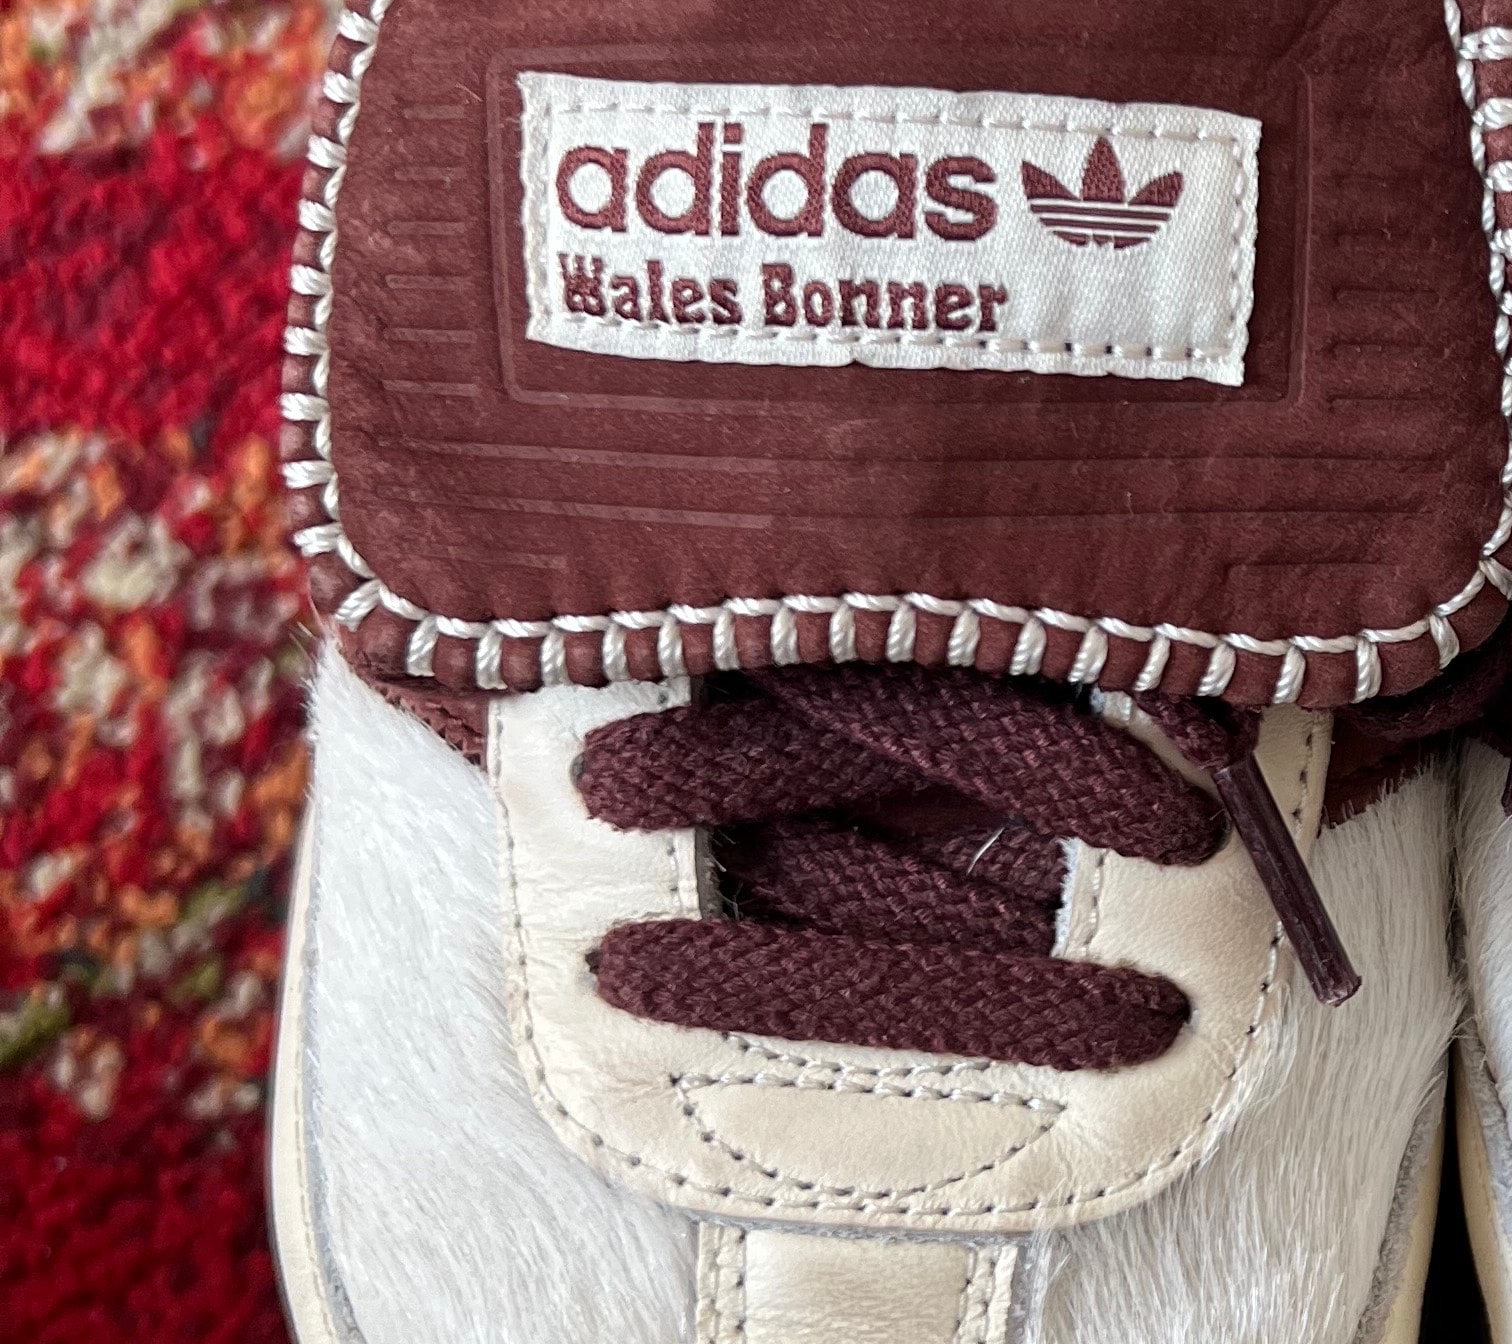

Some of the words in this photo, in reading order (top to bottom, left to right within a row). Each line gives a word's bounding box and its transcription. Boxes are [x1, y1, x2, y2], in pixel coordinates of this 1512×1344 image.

[556, 121, 1000, 242] adidas
[556, 253, 743, 325] Wales
[761, 261, 1009, 332] Bonner
